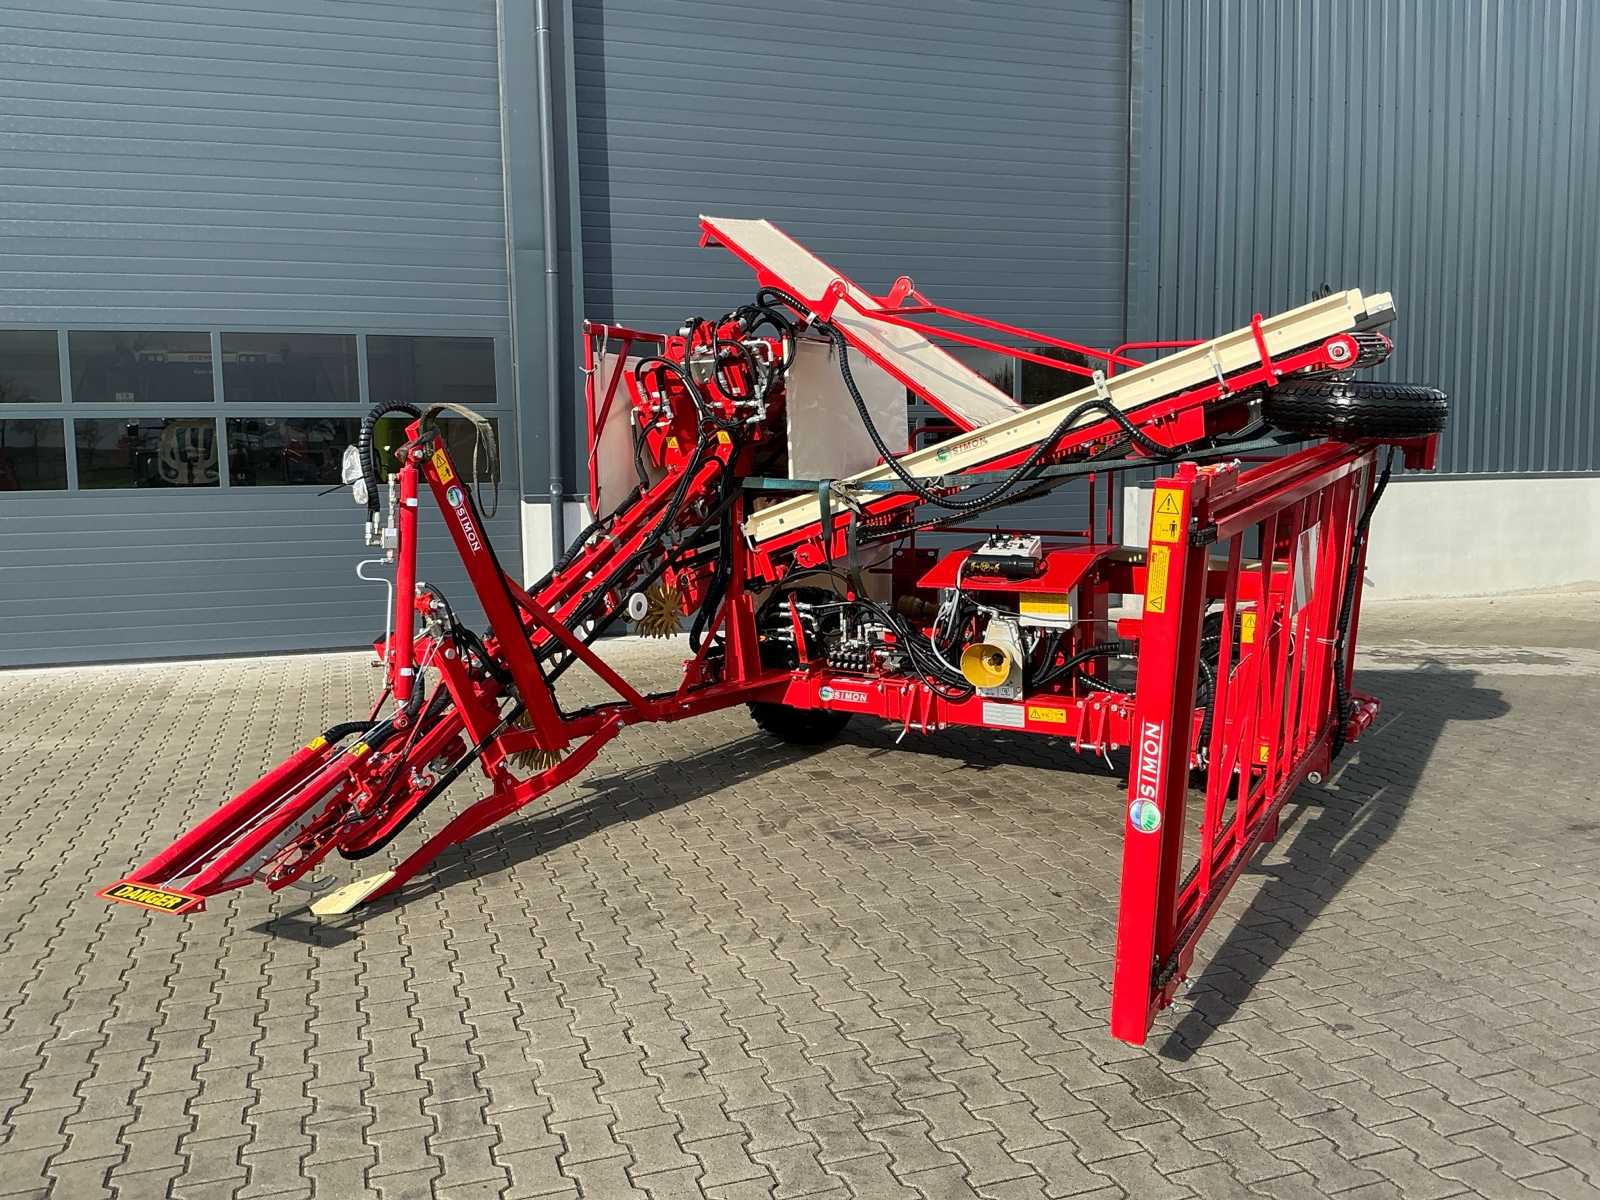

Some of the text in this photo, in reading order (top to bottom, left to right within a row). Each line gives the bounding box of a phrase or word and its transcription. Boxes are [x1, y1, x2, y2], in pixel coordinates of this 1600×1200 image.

[951, 436, 988, 454] SIMON
[457, 507, 481, 552] SIMON
[834, 691, 868, 703] SIMON
[1140, 722, 1160, 798] SIMON
[114, 886, 182, 908] DANGER
